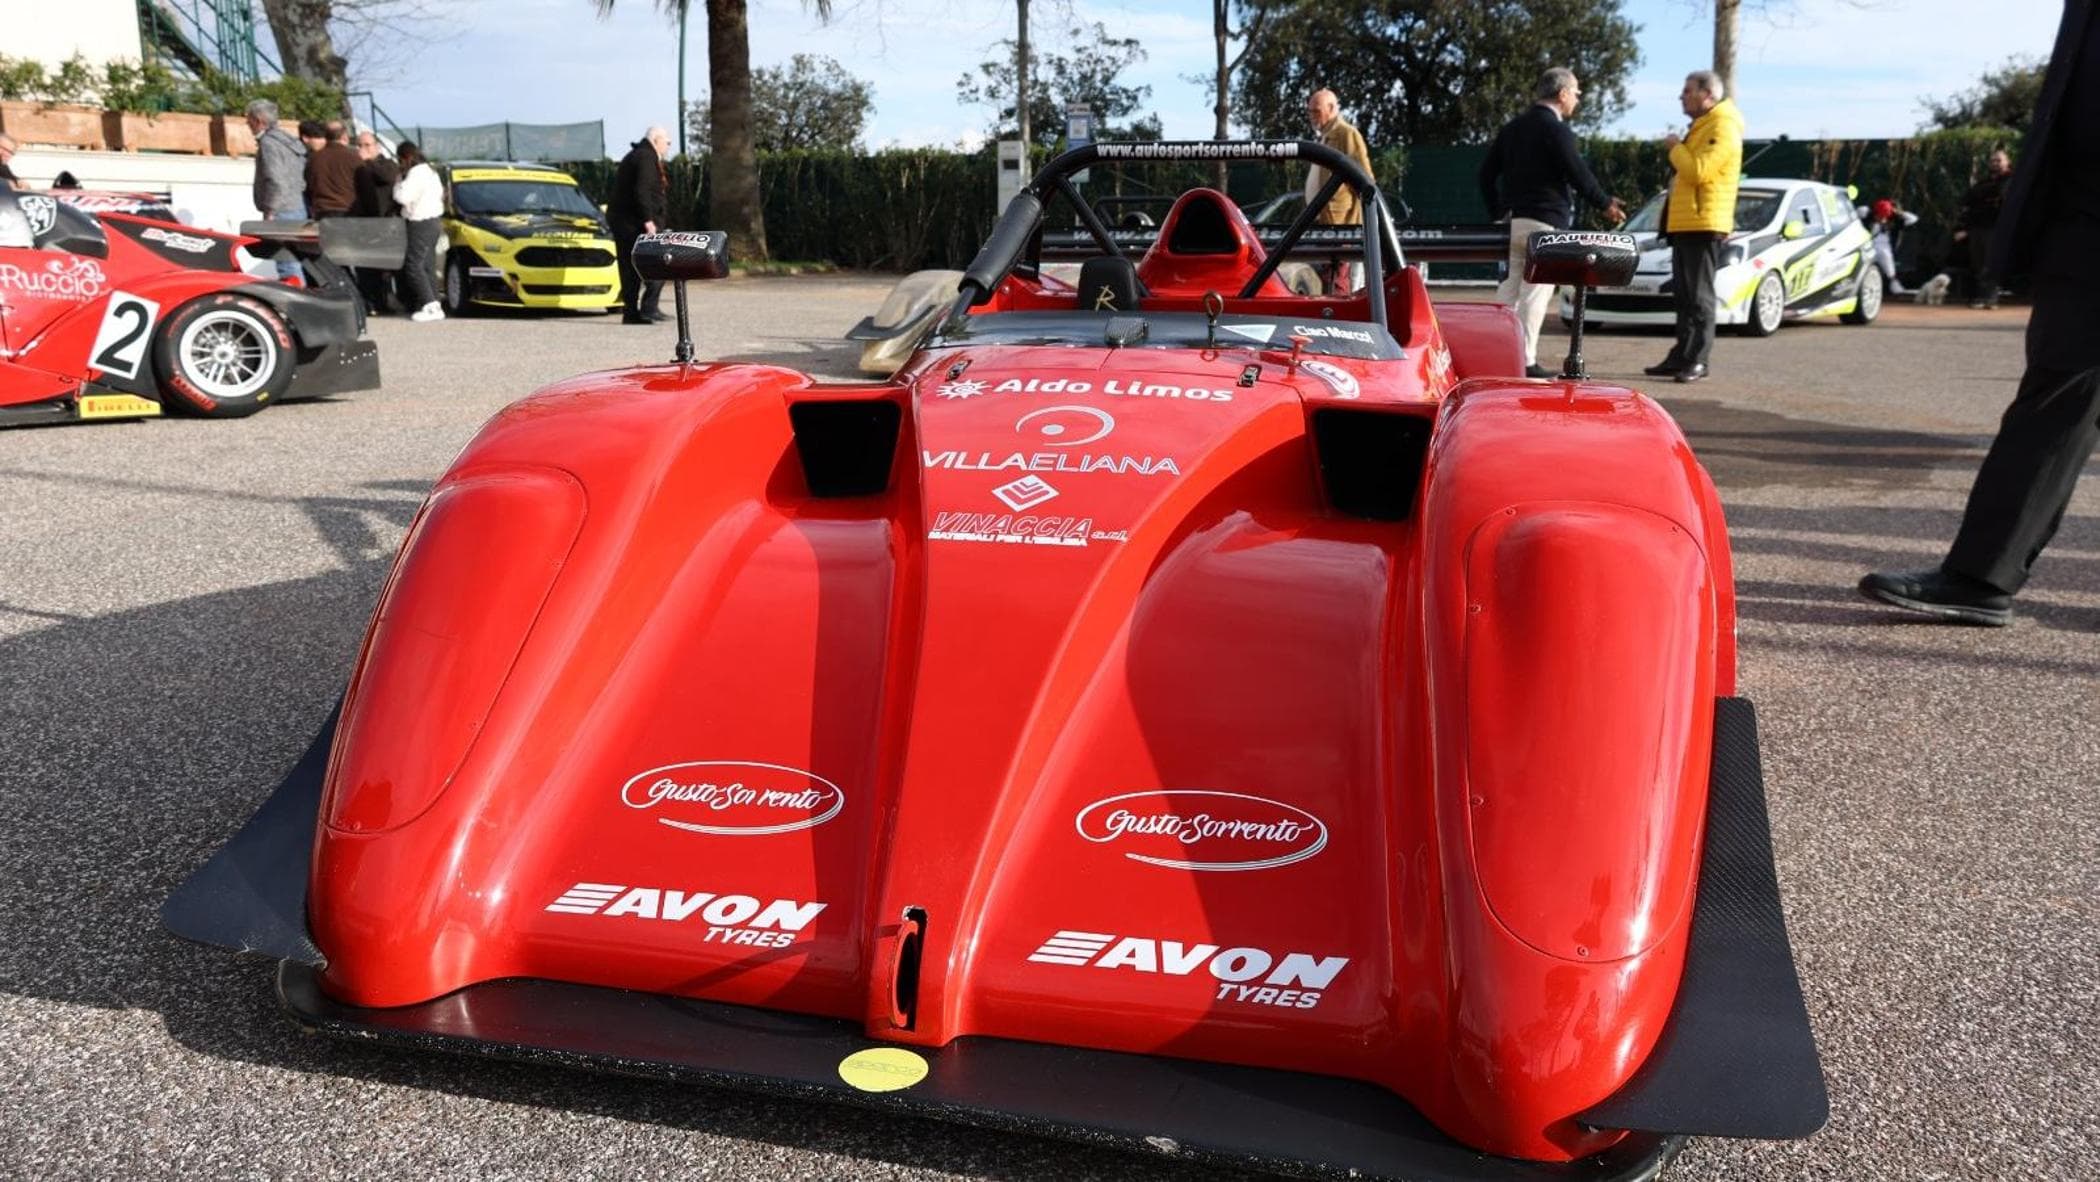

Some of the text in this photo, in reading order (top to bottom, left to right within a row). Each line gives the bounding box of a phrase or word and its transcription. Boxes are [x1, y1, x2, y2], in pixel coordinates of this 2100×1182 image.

[1096, 141, 1299, 158] www.autosportsorrento.com
[1538, 233, 1633, 246] MAURIELLO
[0, 264, 99, 296] Ruccio
[1094, 285, 1118, 312] R
[95, 300, 150, 374] 2
[1294, 325, 1328, 337] Ciao
[993, 378, 1234, 402] Aldo Limos
[932, 511, 1093, 538] VINACCIA
[648, 777, 834, 810] Gusto Sorrento
[1105, 809, 1314, 844] Gusto Sorrento
[603, 888, 827, 931] AVON
[703, 927, 796, 949] TYRES
[1094, 936, 1350, 990] AVON
[1217, 983, 1321, 1009] TYRES
